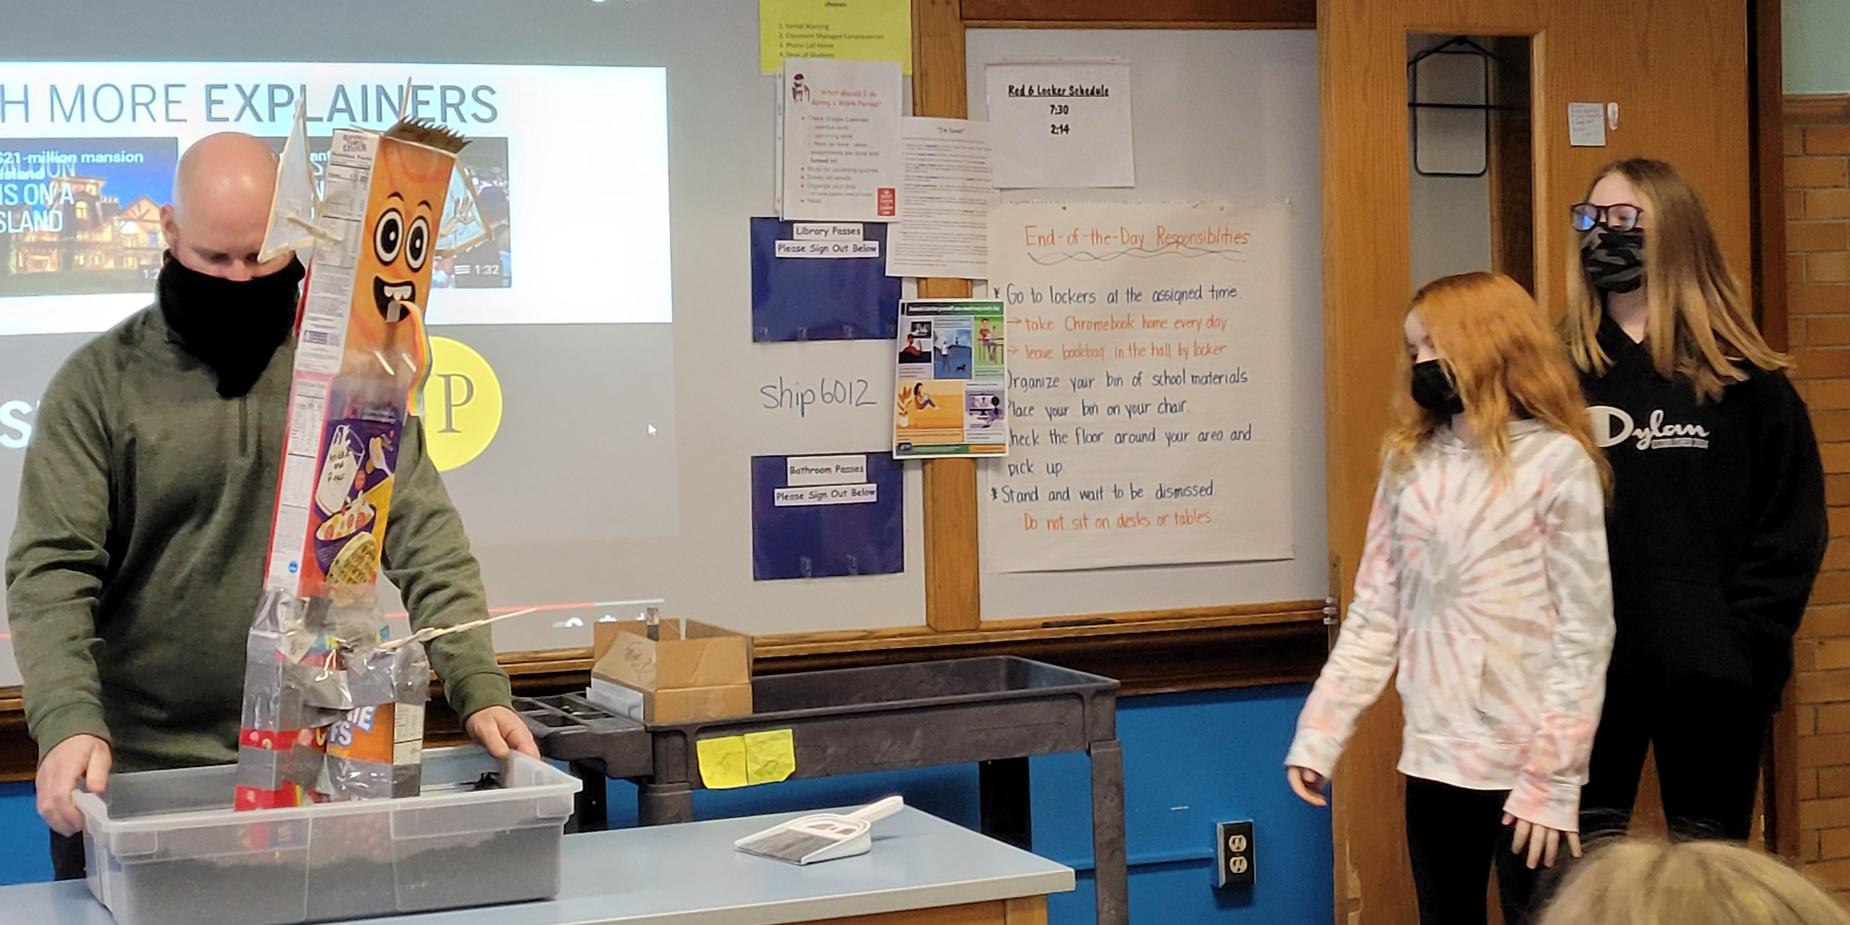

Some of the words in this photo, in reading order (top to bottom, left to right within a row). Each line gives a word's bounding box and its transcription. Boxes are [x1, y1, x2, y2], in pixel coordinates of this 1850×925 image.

[1008, 84, 1025, 97] Red
[1028, 85, 1034, 97] 6
[1037, 84, 1066, 97] Locker
[1069, 84, 1109, 97] Schedule
[50, 83, 188, 123] MORE
[205, 84, 498, 123] EXPLAINERS
[1050, 104, 1069, 115] 7:30
[1050, 124, 1070, 135] 2:14
[81, 150, 144, 163] mansion
[796, 226, 829, 237] Library
[832, 226, 861, 235] Passes
[778, 244, 806, 253] Please
[810, 244, 829, 254] Sign
[832, 244, 849, 253] Out
[853, 244, 877, 252] Below
[474, 264, 500, 276] 1:32
[1006, 283, 1024, 305] Go
[1030, 287, 1043, 304] to
[1050, 285, 1097, 304] lockers
[1107, 288, 1119, 304] at
[1125, 287, 1143, 304] the
[1152, 284, 1203, 305] assigned
[1025, 315, 1055, 332] take
[1064, 313, 1135, 333] Chromebook
[1142, 314, 1168, 329] home
[1174, 318, 1203, 333] every
[1206, 314, 1228, 332] day
[1025, 344, 1054, 360] leave
[1062, 344, 1105, 360] bookbag
[1114, 346, 1125, 359] in
[1128, 342, 1147, 358] the
[1151, 341, 1171, 358] hall
[1177, 342, 1190, 361] by
[1193, 340, 1229, 357] locker
[1070, 377, 1096, 393] your
[1105, 370, 1124, 388] bin
[1131, 371, 1143, 388] of
[1152, 368, 1186, 386] school
[1191, 366, 1249, 385] materials
[1045, 406, 1070, 421] your
[1081, 398, 1099, 416] bin
[1106, 405, 1121, 416] on
[1124, 402, 1152, 420] your
[1049, 428, 1069, 444] the
[1075, 426, 1105, 446] floor
[1114, 427, 1156, 445] around
[1164, 431, 1190, 448] your
[1197, 430, 1224, 443] area
[1230, 423, 1252, 441] and
[1584, 405, 1710, 451] Dylan
[790, 465, 832, 474] Bathroom
[835, 464, 865, 474] Passes
[1046, 462, 1064, 478] up
[776, 492, 805, 501] Please
[808, 491, 827, 501] Sign
[831, 490, 848, 498] Out
[851, 488, 876, 497] Below
[1001, 485, 1039, 503] Stand
[1048, 486, 1070, 502] and
[1080, 486, 1104, 501] wait
[1112, 484, 1124, 499] to
[1130, 482, 1144, 500] be
[1024, 512, 1038, 530] Do
[1047, 514, 1064, 531] not
[1072, 513, 1089, 530] sit
[1095, 517, 1110, 529] on
[1117, 513, 1151, 529] desks
[1156, 514, 1169, 527] or
